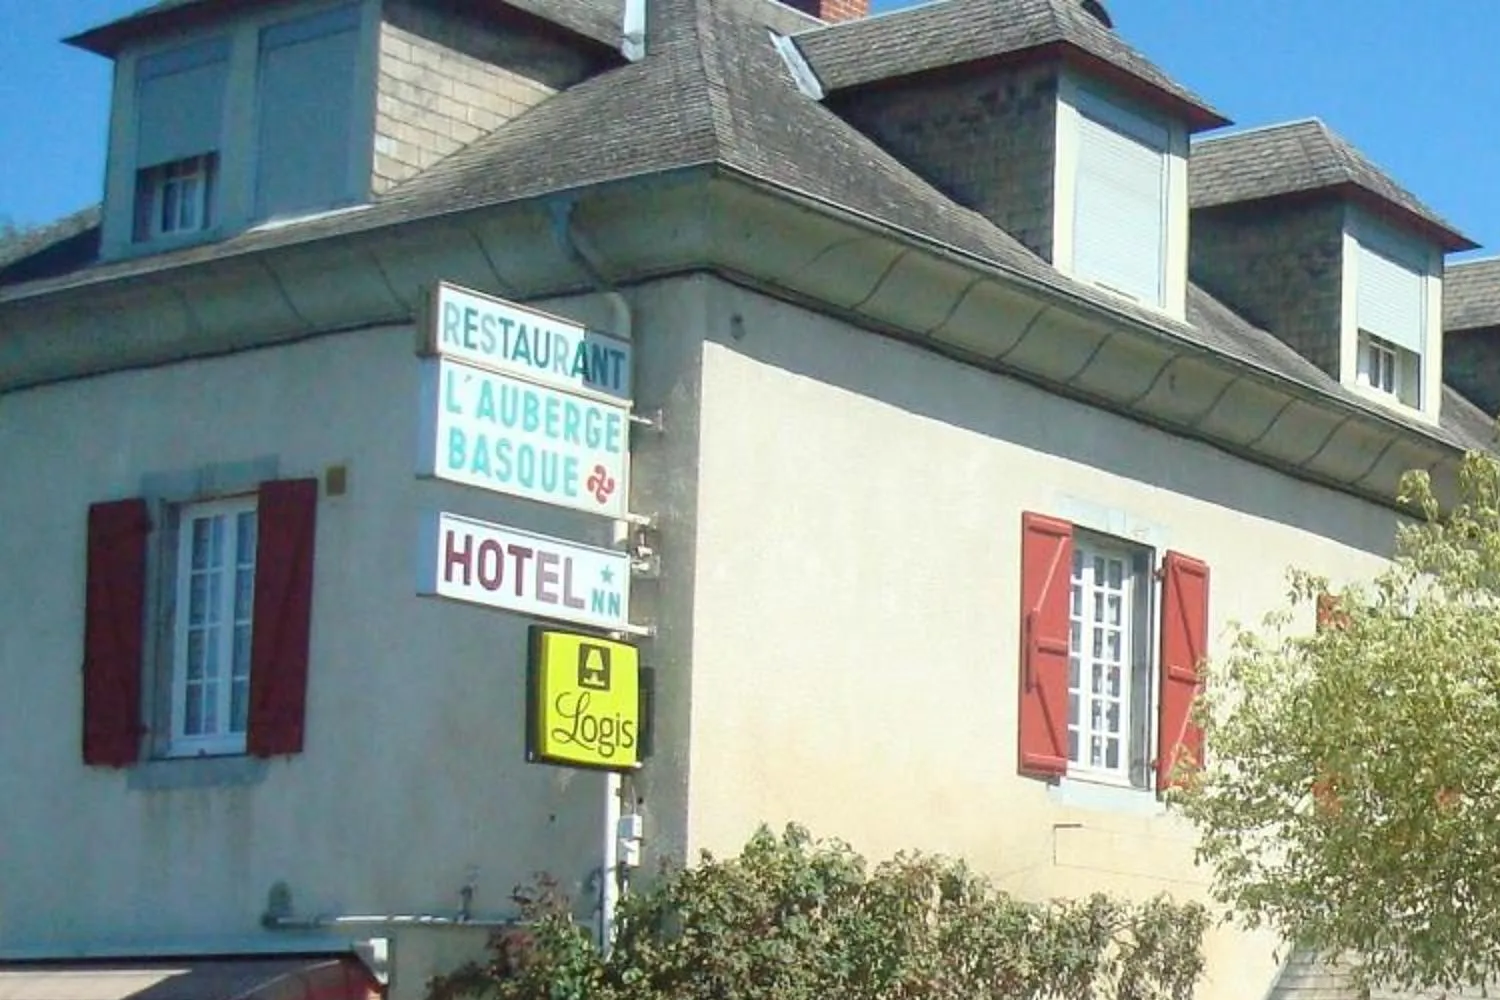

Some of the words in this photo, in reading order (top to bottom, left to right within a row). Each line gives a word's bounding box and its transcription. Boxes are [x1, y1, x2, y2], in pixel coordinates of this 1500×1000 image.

[443, 301, 626, 390] RESTAURANT
[446, 370, 621, 455] L'AUBERGE
[448, 426, 580, 497] BASQUE
[444, 530, 586, 610] HOTEL
[591, 588, 621, 618] NN
[551, 691, 634, 758] Logis
